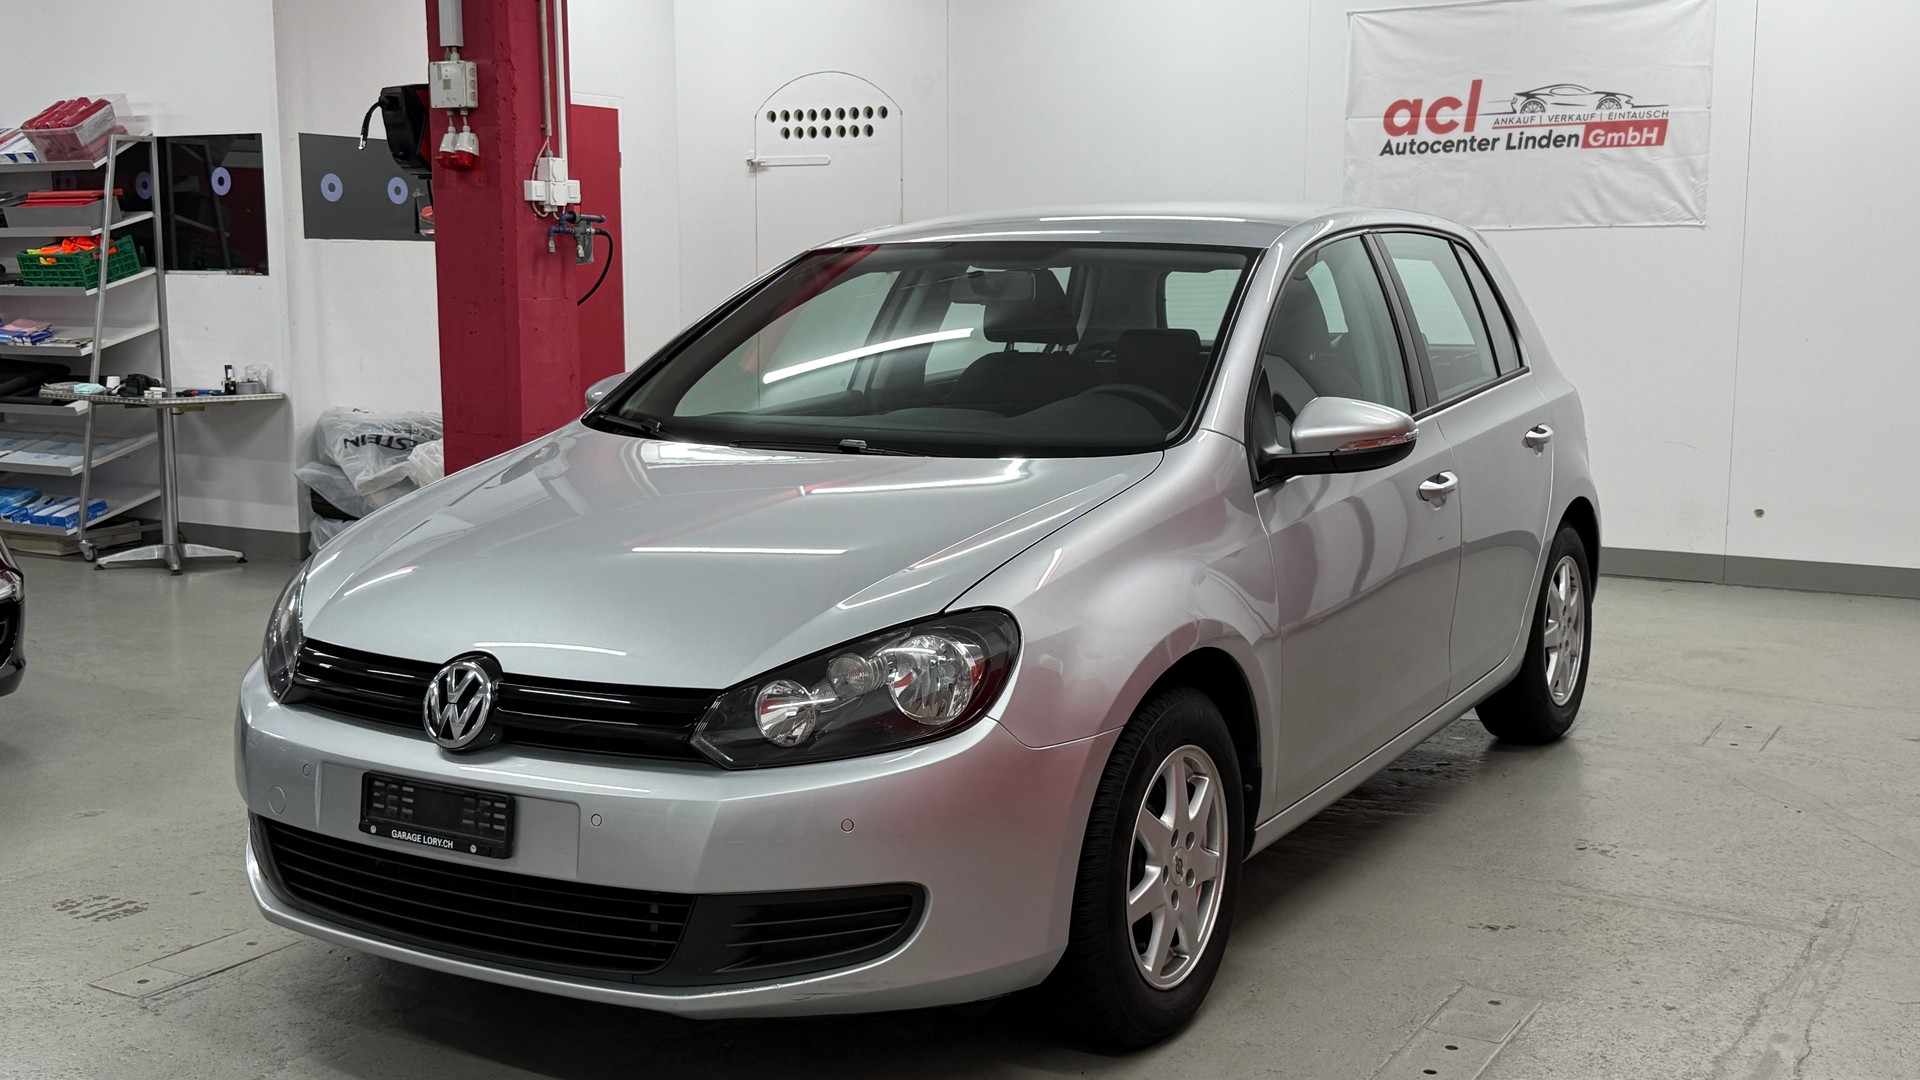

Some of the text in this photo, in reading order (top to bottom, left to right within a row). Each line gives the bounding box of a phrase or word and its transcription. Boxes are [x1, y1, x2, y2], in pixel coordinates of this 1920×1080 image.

[1382, 79, 1483, 137] acl
[1493, 109, 1669, 126] ANKAUF VERKAUF EINTAUSCH
[1379, 126, 1659, 157] Autocenter Linden GmbH
[391, 829, 454, 849] GARAGE LORY.CH
